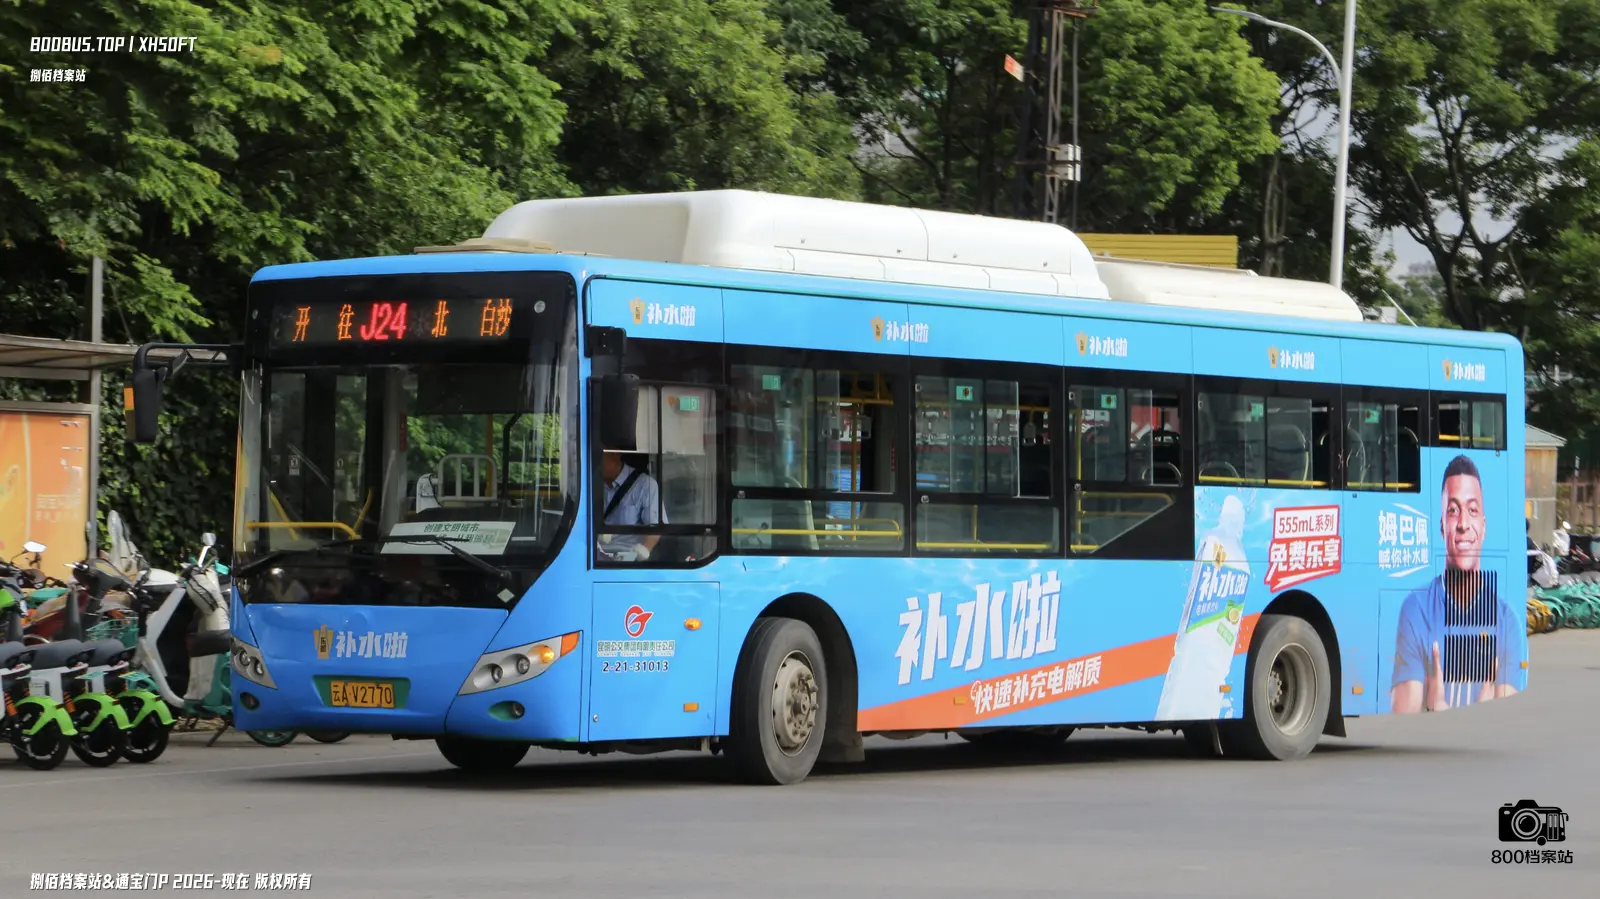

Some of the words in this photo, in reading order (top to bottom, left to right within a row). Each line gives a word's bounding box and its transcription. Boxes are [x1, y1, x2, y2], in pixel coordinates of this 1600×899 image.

[360, 301, 408, 341] J24
[646, 301, 697, 327] 补水啦
[885, 319, 930, 343] 补水啦
[1089, 334, 1128, 357] 补水啦
[423, 523, 480, 533] 创建文明城市
[1279, 513, 1335, 534] 555mL系列
[1378, 509, 1429, 546] 姆巴佩
[1266, 538, 1341, 582] 免费乐享
[1199, 566, 1248, 602] 补水啦
[895, 570, 1062, 685] 补水啦
[335, 630, 409, 659] 补水啦
[602, 661, 670, 673] 2-21-31013
[973, 655, 1103, 715] 快速补充电解质
